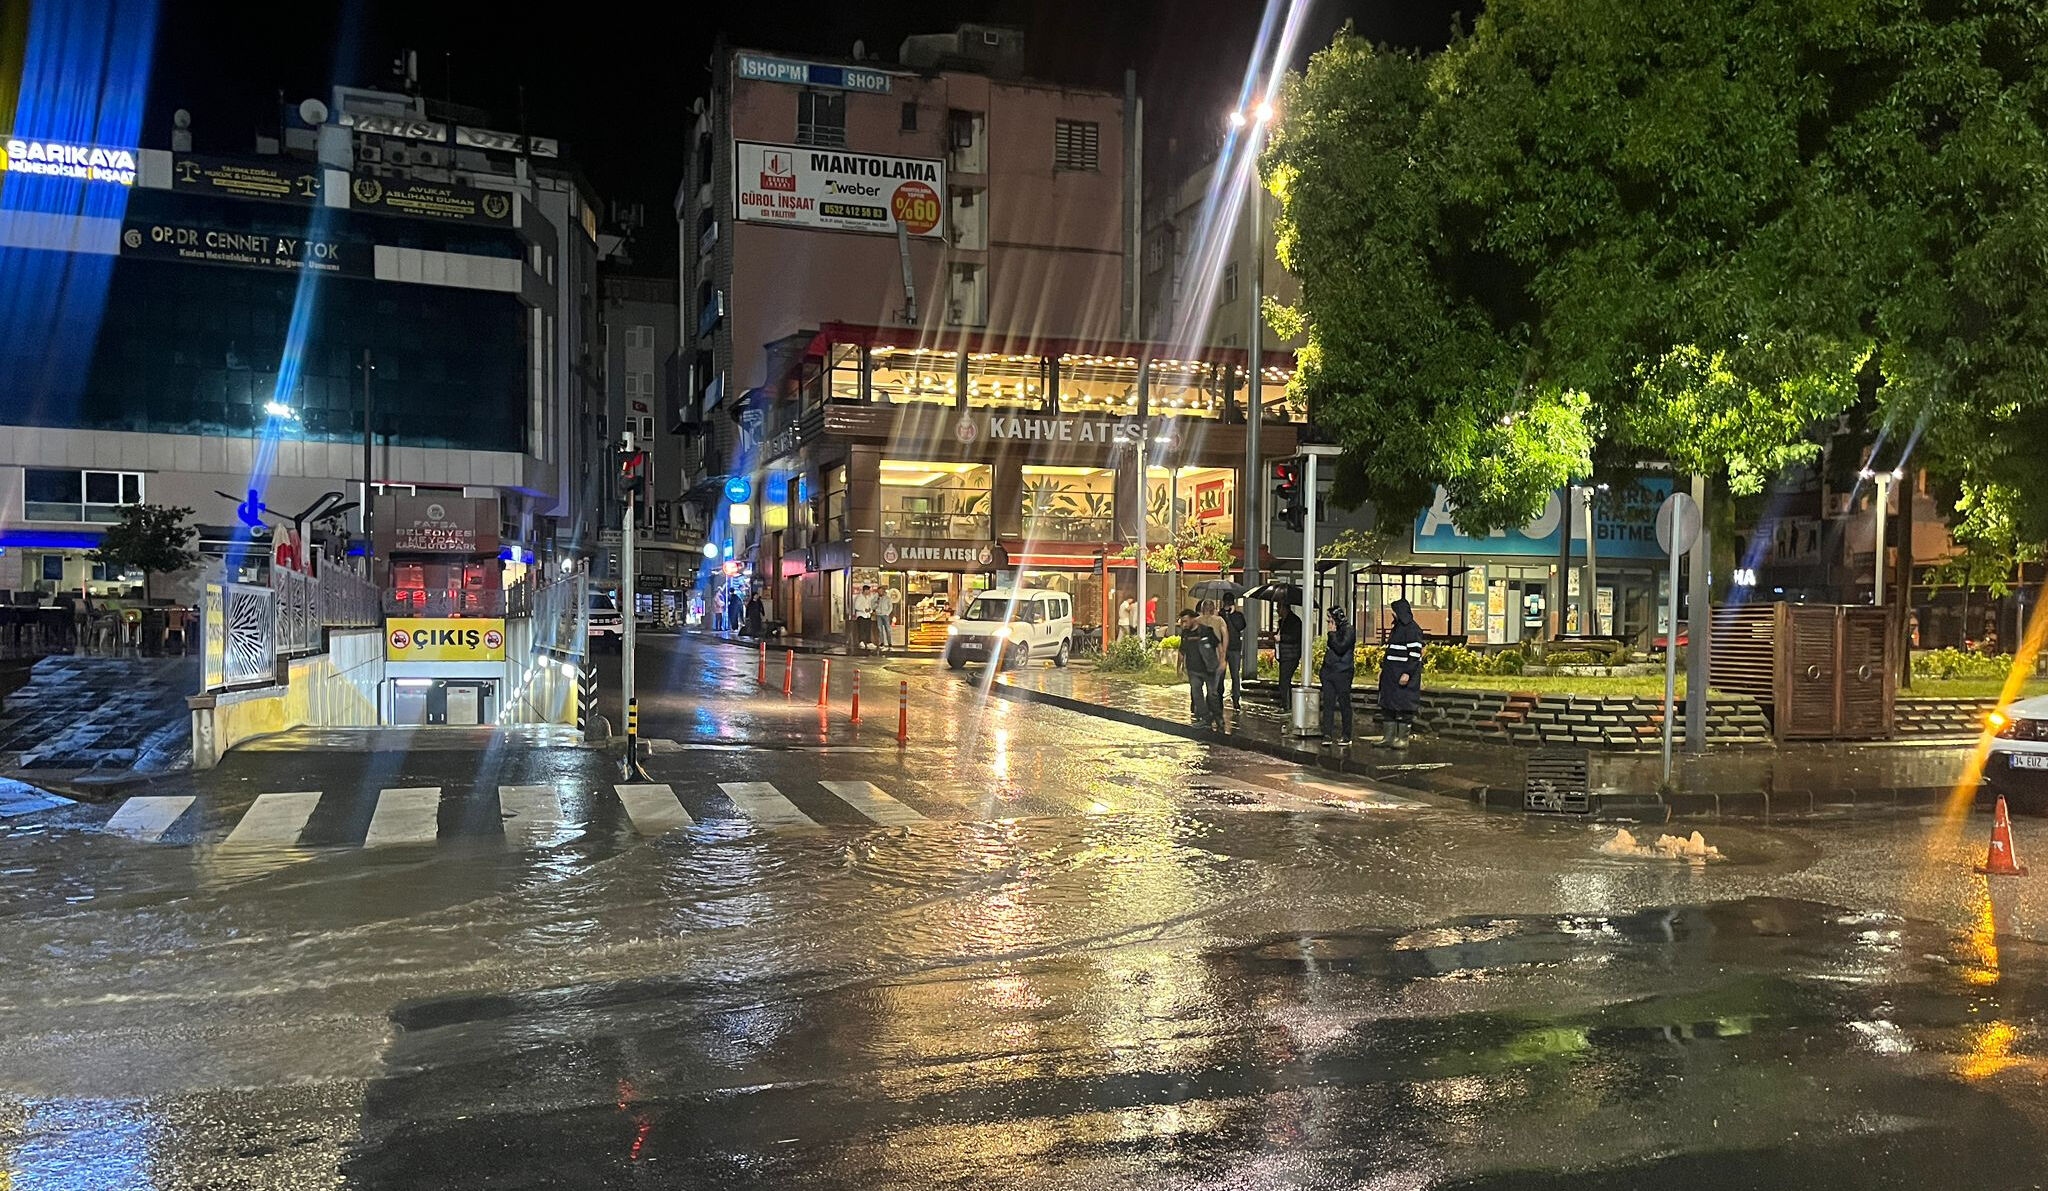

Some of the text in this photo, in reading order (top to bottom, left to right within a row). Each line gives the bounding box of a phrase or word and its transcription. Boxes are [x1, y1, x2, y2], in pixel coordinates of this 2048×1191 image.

[7, 140, 136, 171] SARIKAYA
[810, 153, 937, 183] MANTOLAMA
[409, 186, 452, 196] AVUKAT
[836, 181, 881, 197] weber
[436, 196, 475, 206] DUMAN
[741, 191, 816, 211] GÜROL İNŞAAT
[895, 197, 937, 222] %60
[205, 231, 270, 253] CENNET
[276, 238, 297, 255] AY
[304, 241, 339, 260] TOK
[260, 256, 271, 265] ve
[990, 417, 1073, 442] KAHVE
[414, 520, 458, 529] FATSA
[408, 536, 465, 545] MEYDAN
[448, 543, 477, 551] PARK
[901, 547, 940, 560] KAHVE
[412, 629, 480, 650] ÇIKIŞ
